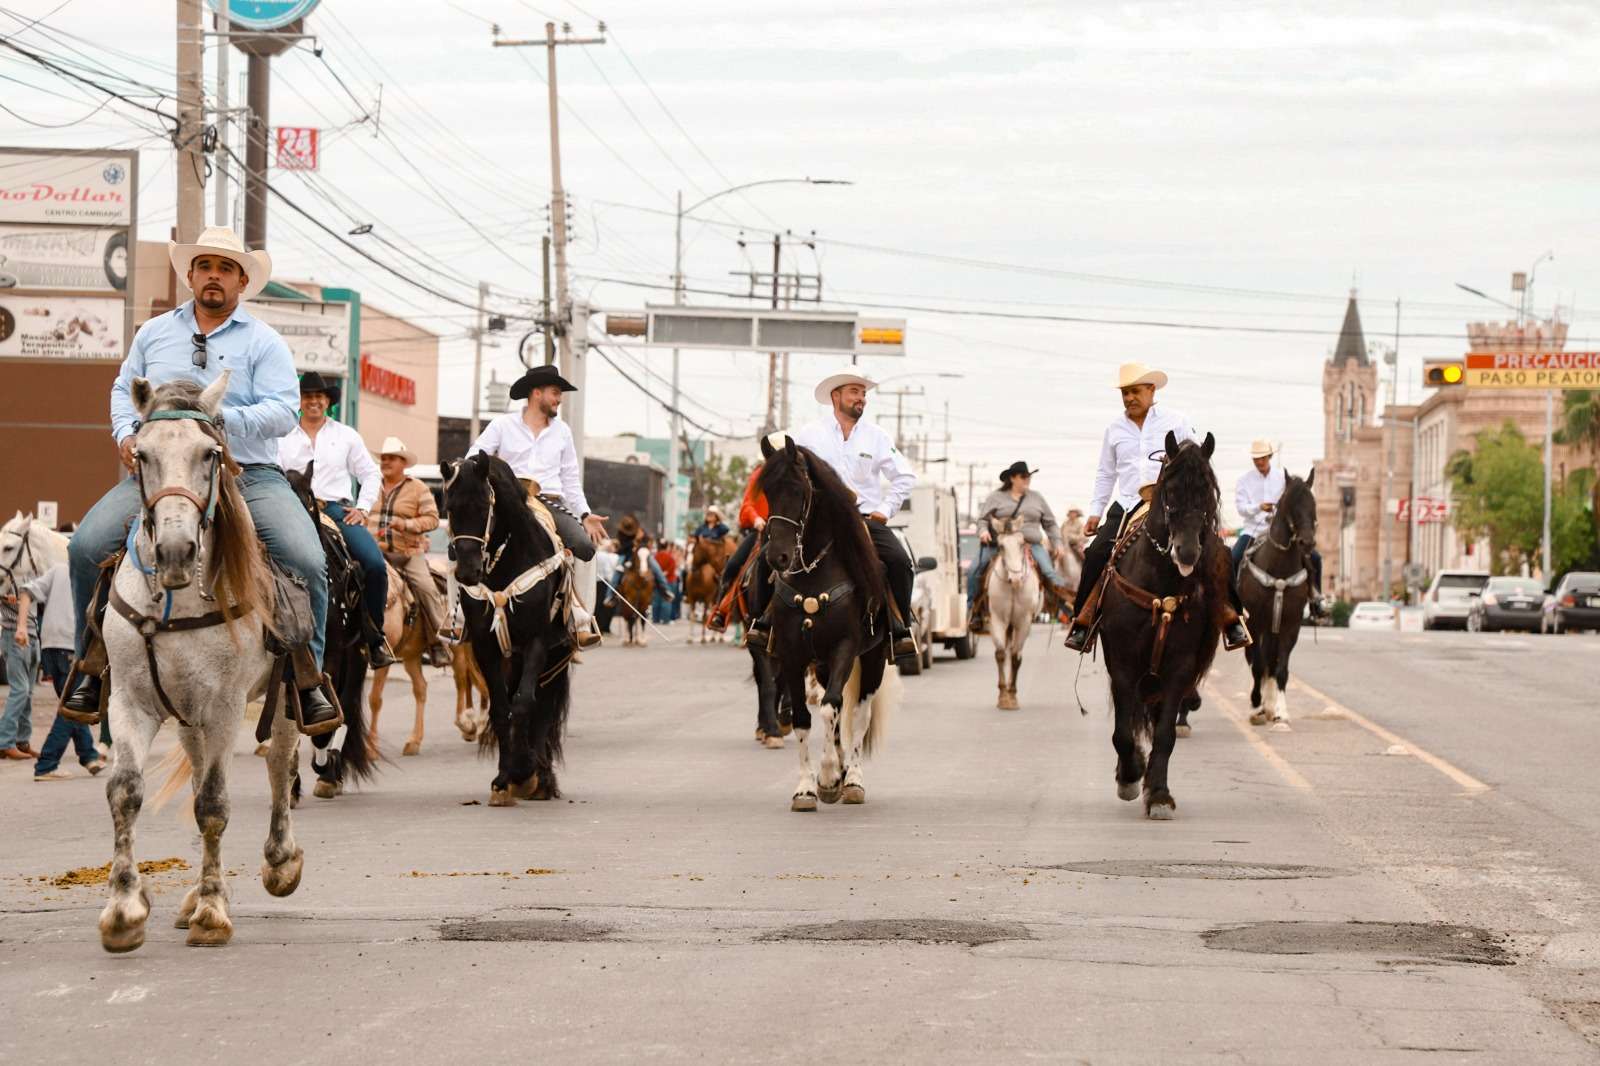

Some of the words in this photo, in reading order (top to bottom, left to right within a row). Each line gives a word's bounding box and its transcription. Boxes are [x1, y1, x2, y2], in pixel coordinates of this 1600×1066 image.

[45, 209, 77, 217] CENTRO
[79, 209, 122, 217] CAMBIARIO
[1480, 371, 1527, 385] PASO
